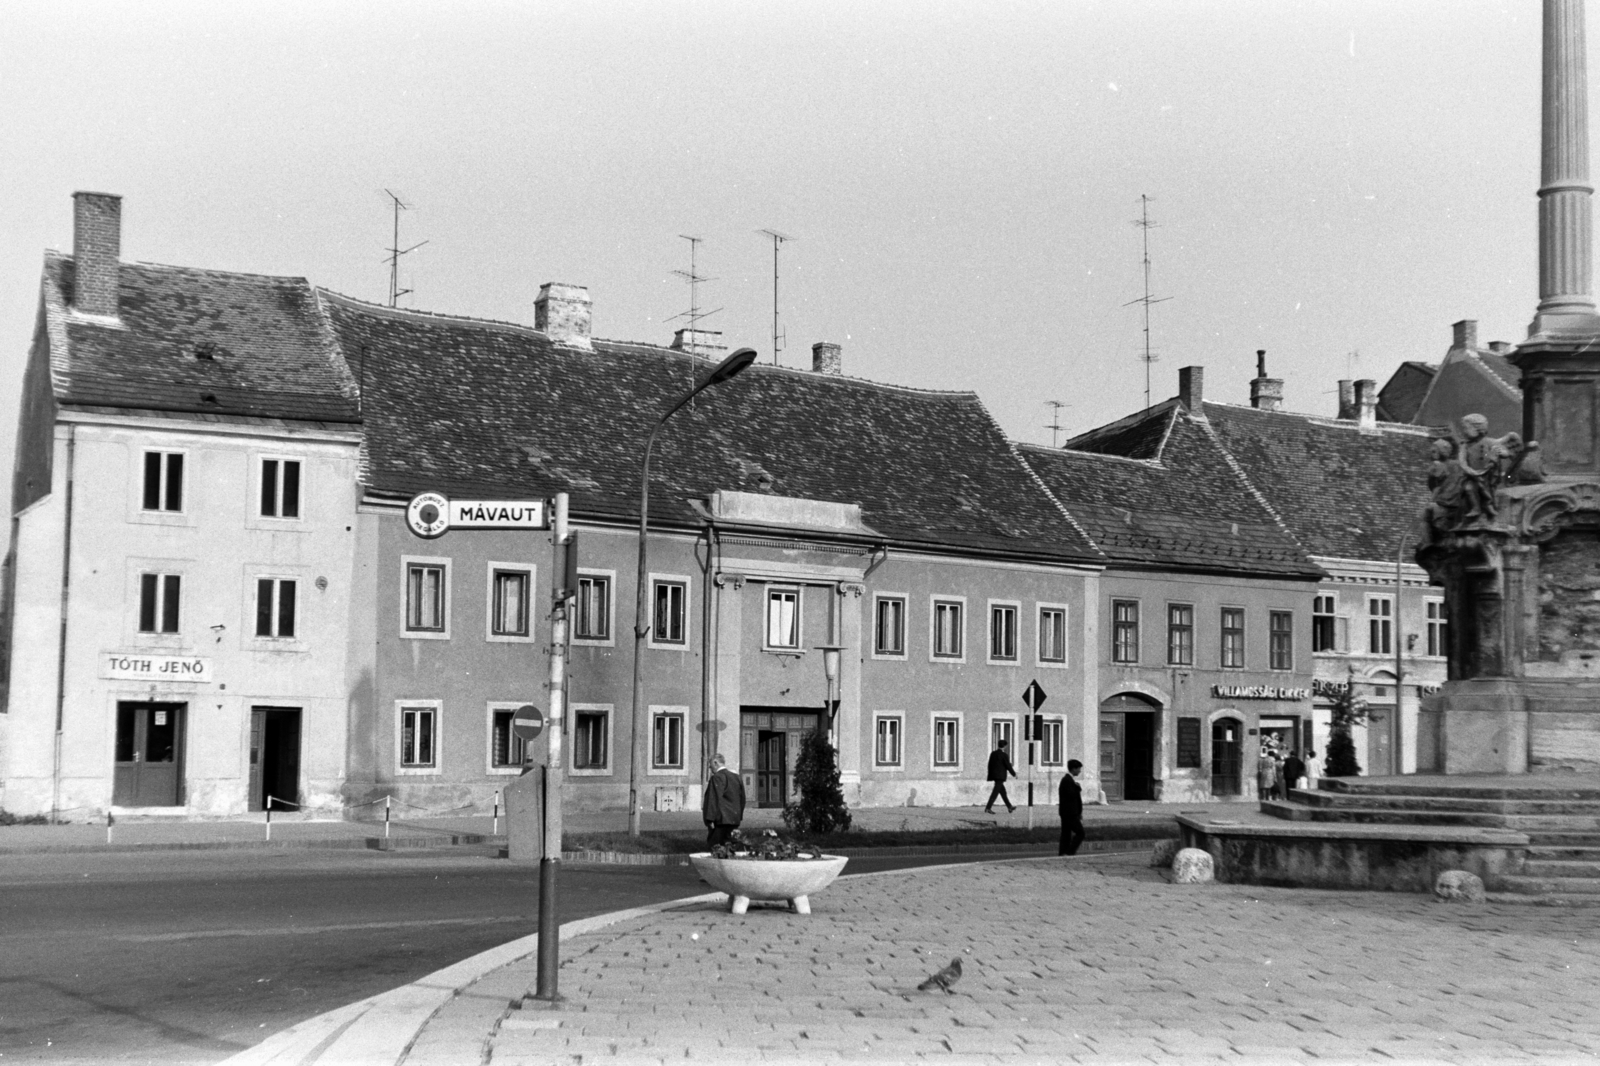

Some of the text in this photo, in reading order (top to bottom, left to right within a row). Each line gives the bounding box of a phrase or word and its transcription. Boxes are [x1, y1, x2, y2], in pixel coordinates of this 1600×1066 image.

[460, 503, 536, 521] MÁVAUT
[109, 656, 203, 674] TÓTH JENŐ
